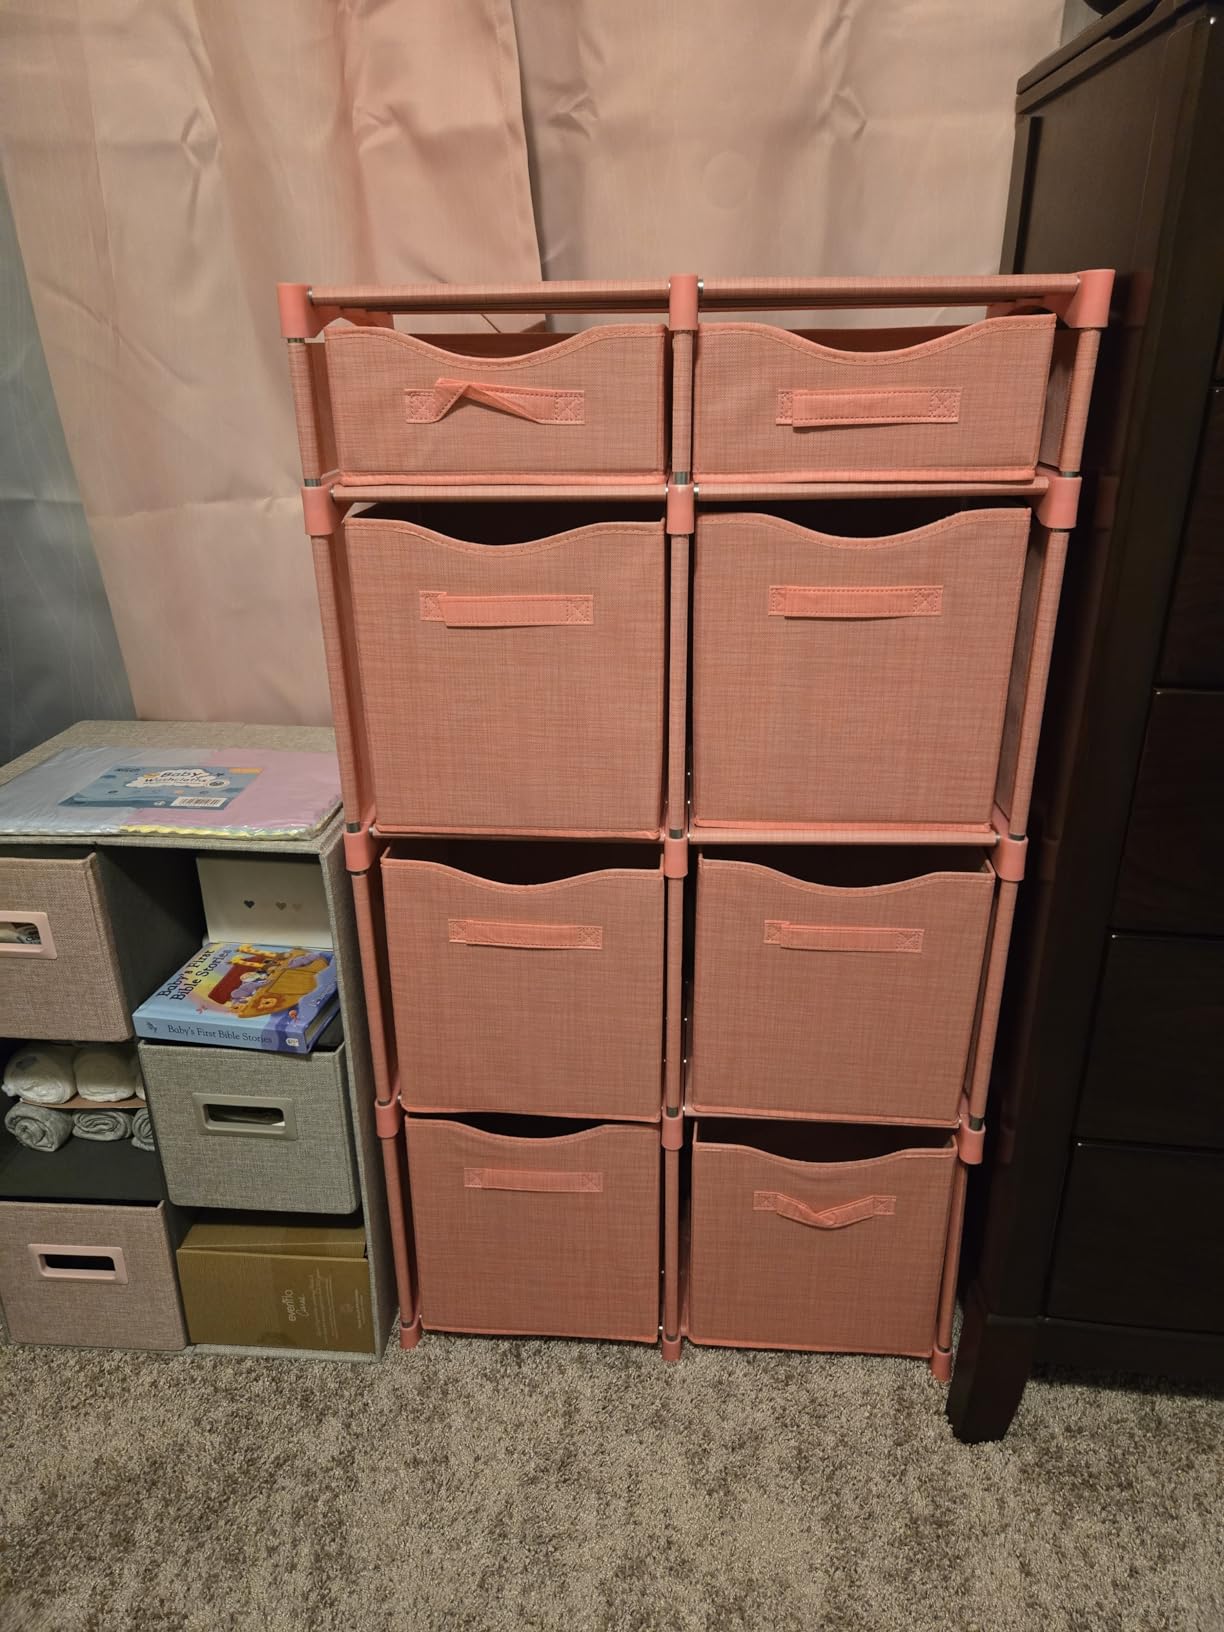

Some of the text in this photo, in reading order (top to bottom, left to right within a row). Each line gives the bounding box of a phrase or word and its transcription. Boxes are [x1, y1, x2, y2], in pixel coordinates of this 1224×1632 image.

[157, 950, 215, 996] Baby's First
[169, 950, 232, 1000] Bible Stories
[168, 1025, 272, 1043] Baby's First Bible Stories
[282, 1289, 297, 1321] evenflo
